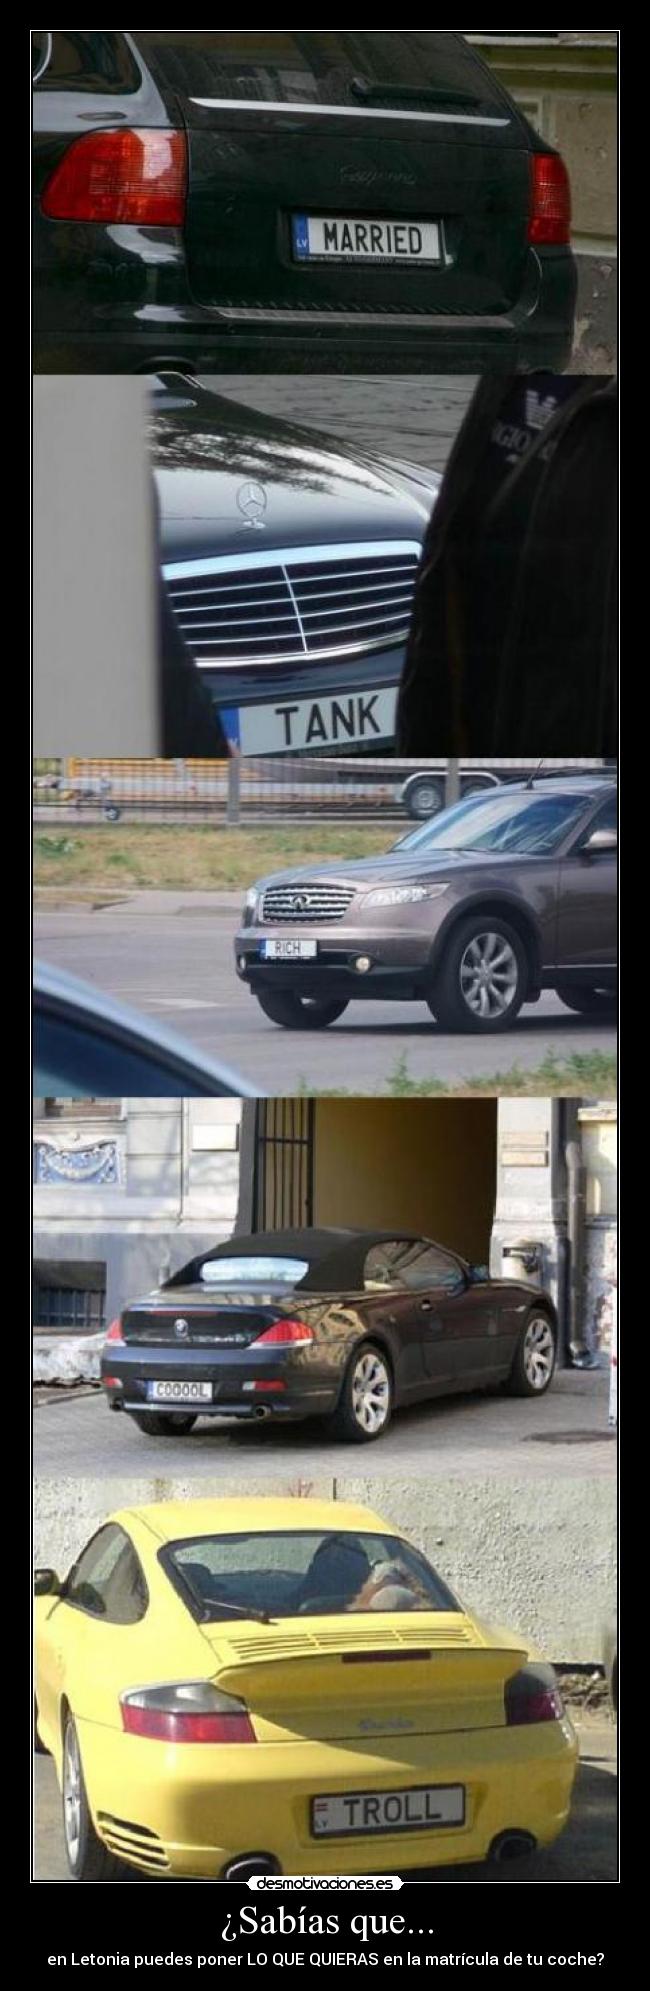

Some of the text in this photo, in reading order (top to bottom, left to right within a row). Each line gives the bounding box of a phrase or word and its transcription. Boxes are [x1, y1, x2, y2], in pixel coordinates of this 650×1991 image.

[296, 239, 308, 248] LV
[324, 222, 423, 255] MARRIED
[275, 695, 381, 746] TANK
[274, 941, 302, 955] RICH
[343, 1793, 442, 1827] TROLL
